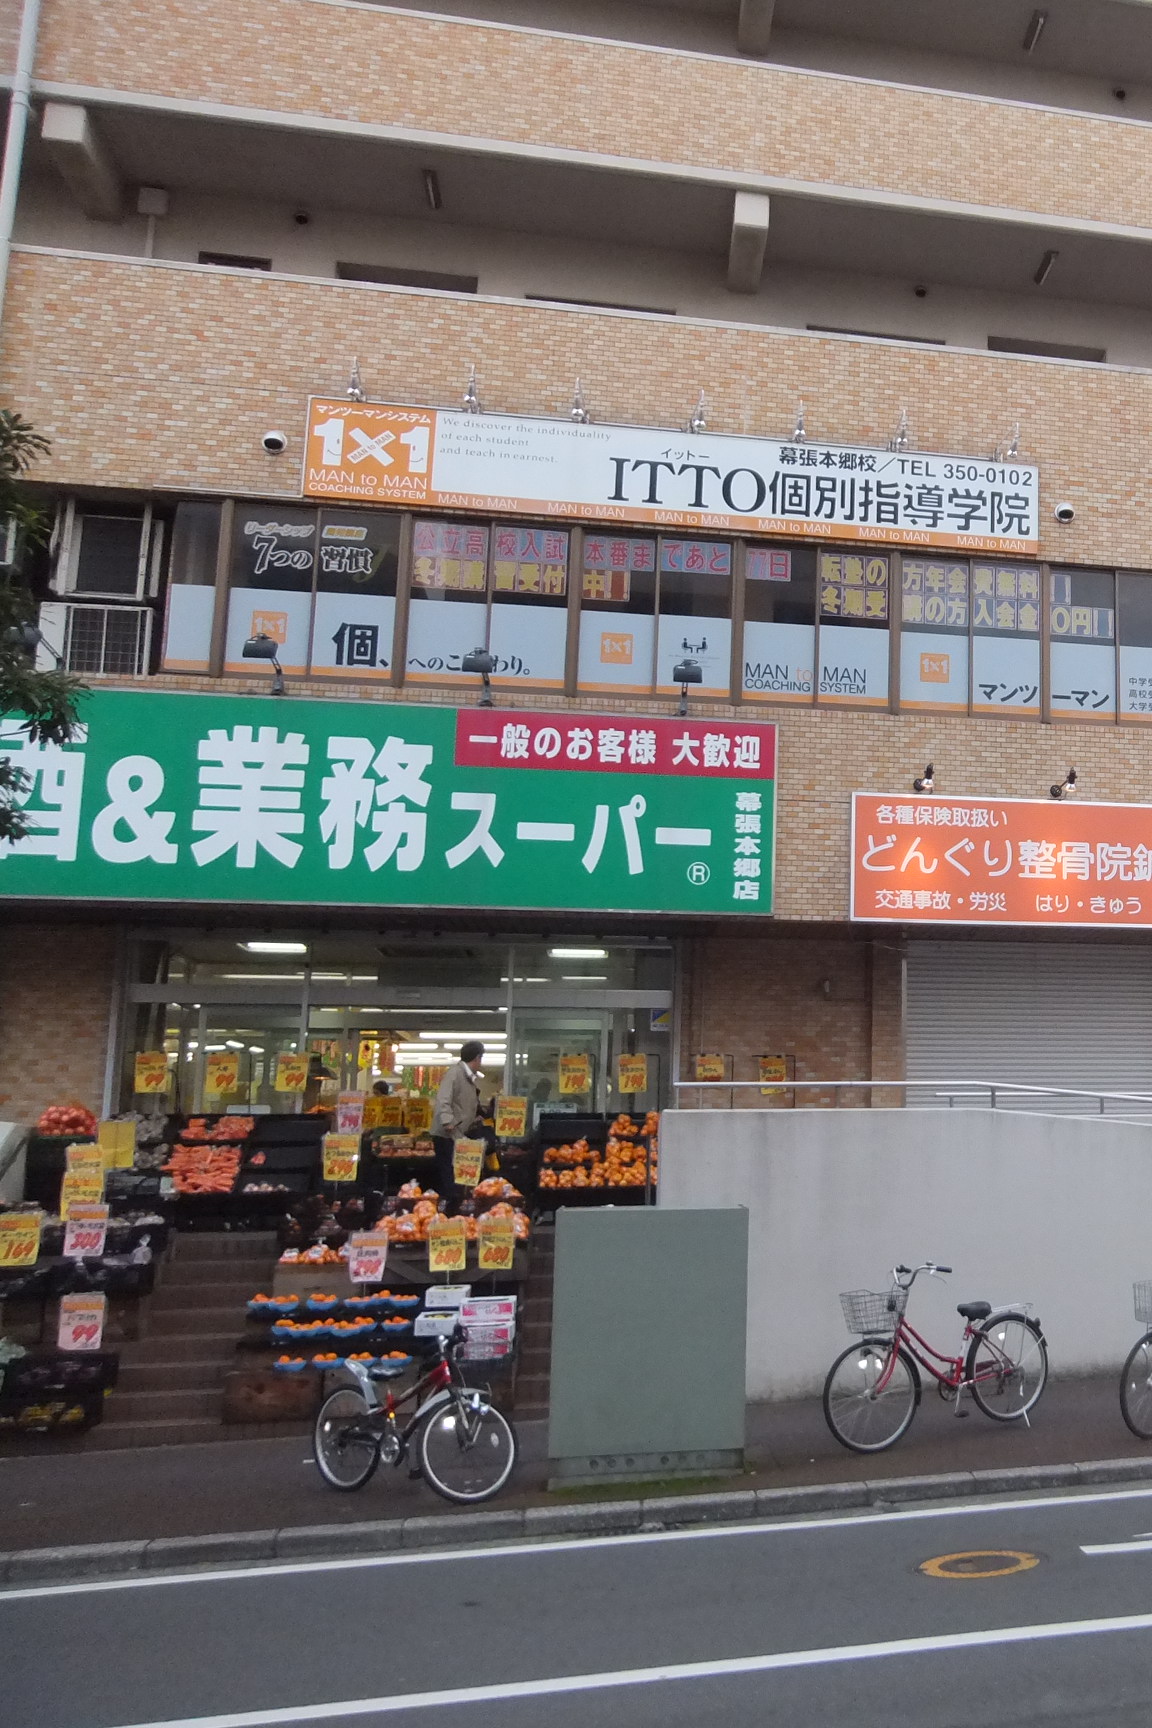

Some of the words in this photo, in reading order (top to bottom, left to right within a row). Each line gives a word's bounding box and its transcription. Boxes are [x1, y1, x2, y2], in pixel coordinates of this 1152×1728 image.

[316, 405, 431, 424] マンツーマンシステム
[443, 417, 460, 426] We
[463, 420, 512, 431] discover
[516, 424, 533, 433] the
[537, 425, 612, 442] individuality
[441, 432, 452, 440] of
[456, 434, 482, 443] each
[486, 437, 529, 447] student
[440, 447, 461, 455] and
[465, 449, 496, 458] teach
[500, 451, 511, 460] in
[513, 454, 559, 464] earnest.
[661, 449, 710, 460] イットー
[310, 468, 354, 484] MAN
[361, 474, 377, 486] to
[383, 474, 427, 490] MAN
[943, 463, 1033, 487] 350-0102
[309, 482, 373, 495] COACHING
[377, 488, 426, 499] SYSTEM
[438, 493, 468, 506] MAN
[473, 496, 484, 507] to
[487, 498, 517, 510] MAN
[548, 502, 577, 514] MAN
[581, 506, 592, 516] to
[595, 506, 624, 518] MAN
[654, 511, 683, 523] MAN
[687, 514, 698, 524] to
[701, 514, 729, 526] MAN
[758, 519, 787, 530] MAN
[790, 522, 800, 532] to
[803, 523, 831, 535] MAN
[859, 527, 886, 538] MAN
[889, 530, 900, 540] to
[903, 531, 929, 543] MAN
[957, 535, 983, 547] MAN
[986, 538, 997, 548] to
[1000, 539, 1026, 551] MAN
[408, 653, 531, 676] へのこわり。
[745, 662, 788, 680] MAN
[796, 667, 813, 681] to
[823, 666, 866, 684] MAN
[745, 678, 811, 692] COACHING
[820, 682, 866, 694] SYSTEM
[469, 723, 657, 765] 一般のお客様
[672, 732, 761, 769] 大歓迎
[875, 804, 1008, 828] 各種保険取扱い
[733, 791, 762, 900] 幕張本郷店
[875, 889, 1007, 912] 交通事故・労災
[1035, 894, 1142, 916] はり・きゅう
